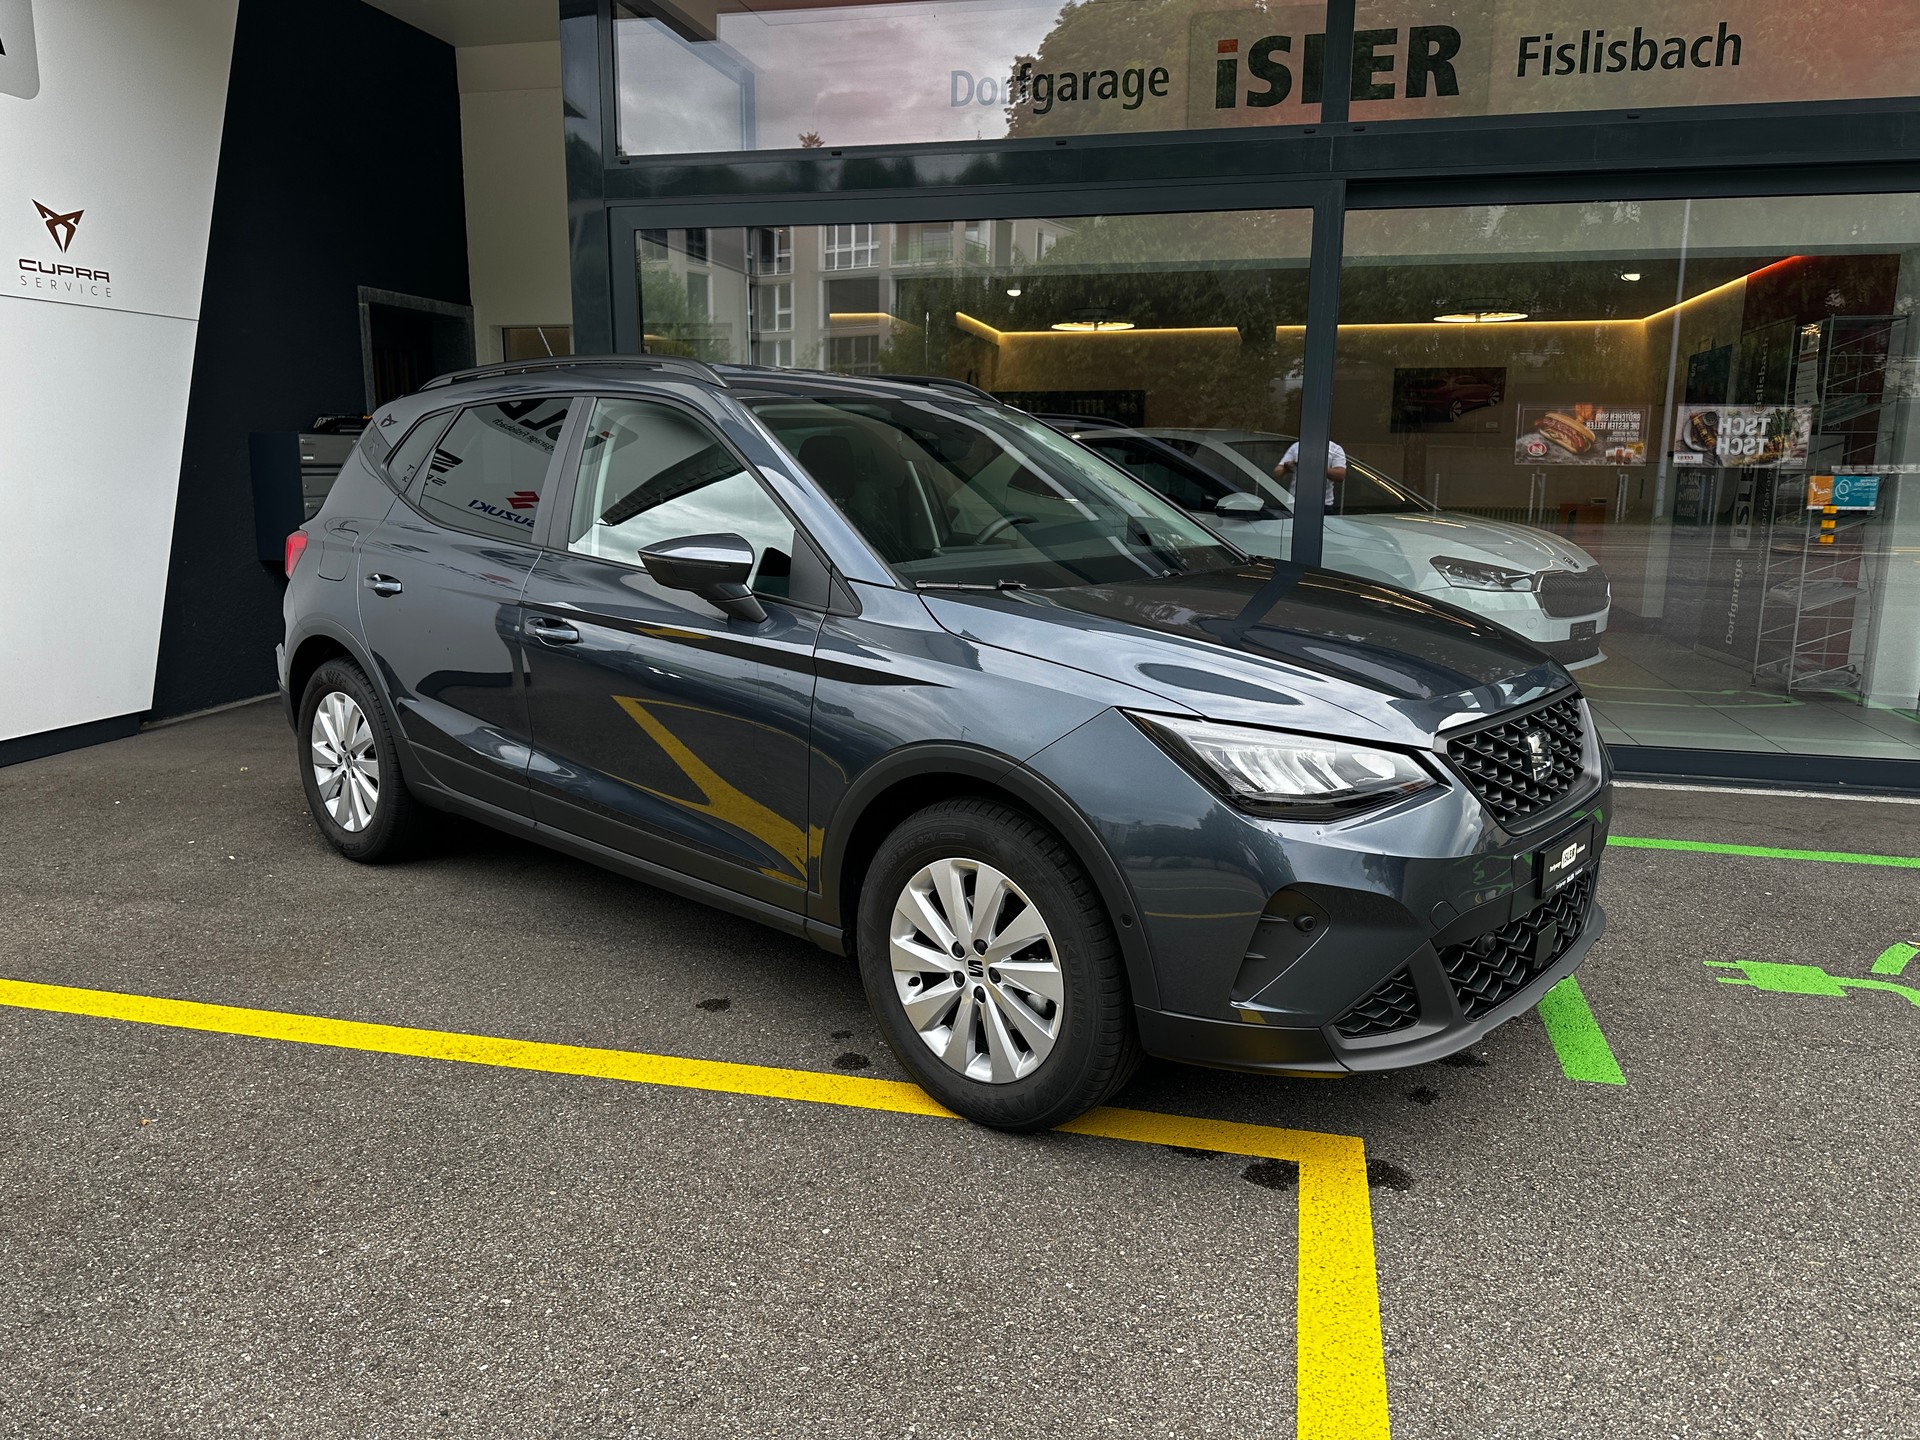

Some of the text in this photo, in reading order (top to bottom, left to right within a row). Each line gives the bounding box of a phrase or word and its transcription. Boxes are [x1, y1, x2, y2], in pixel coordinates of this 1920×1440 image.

[949, 62, 1170, 115] Dorfgarage
[1516, 21, 1743, 78] Fislisbach
[18, 258, 110, 283] CUPRA
[19, 275, 112, 298] SERVICE
[1725, 559, 1743, 645] Dorfgarage
[1063, 937, 1084, 1039] KUMHO
